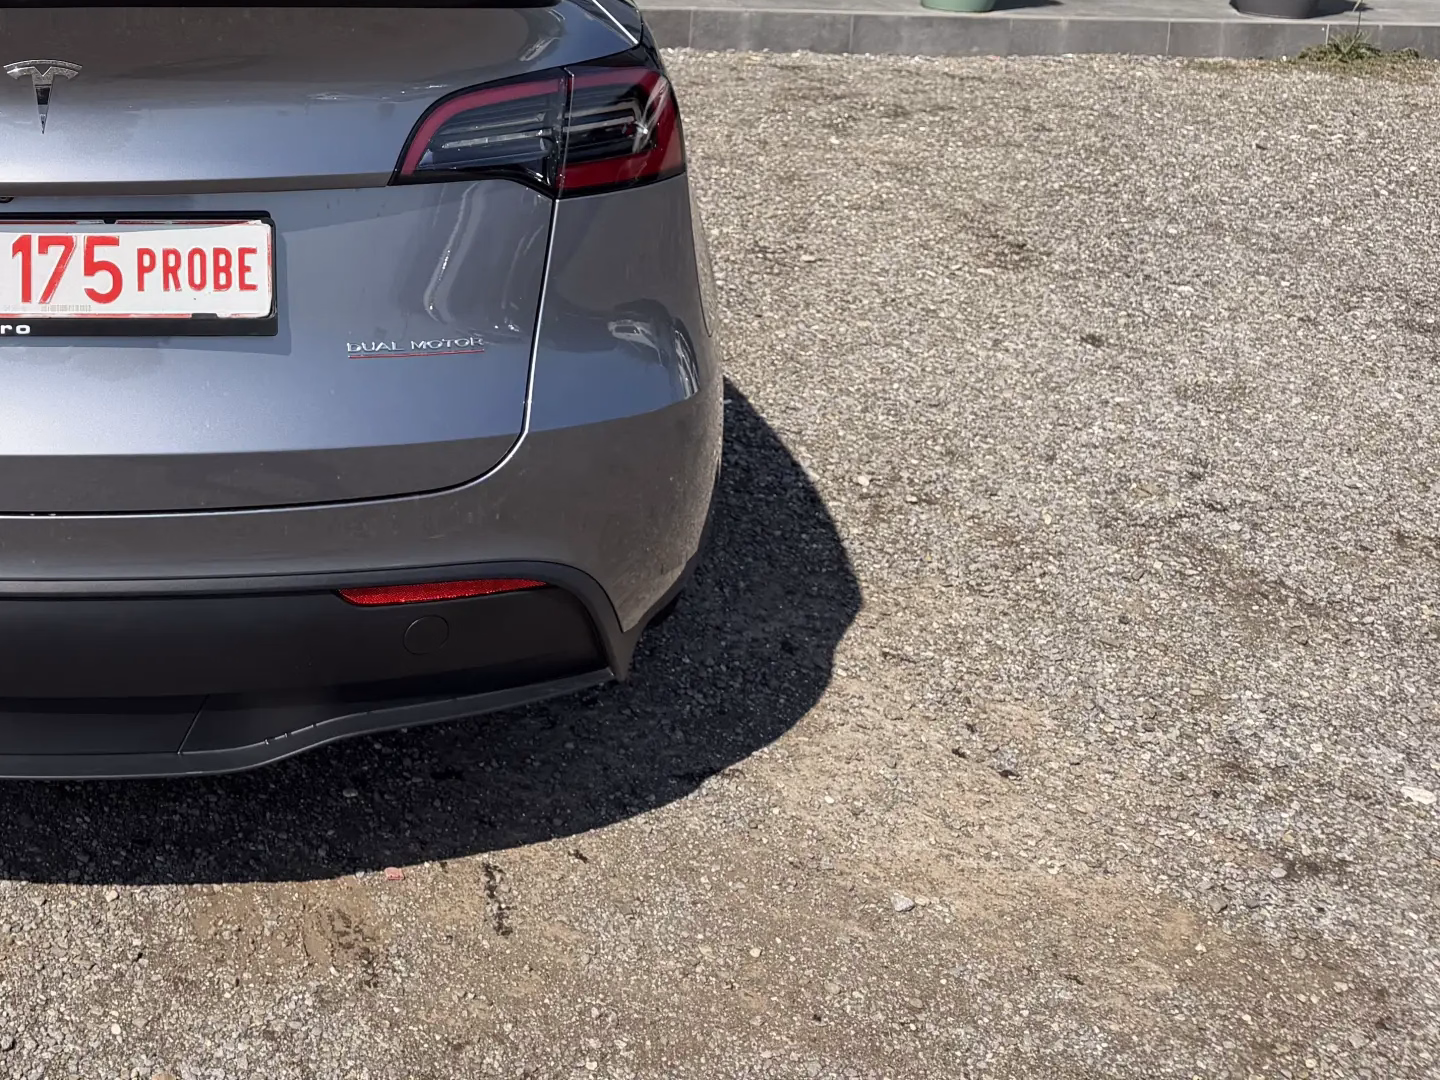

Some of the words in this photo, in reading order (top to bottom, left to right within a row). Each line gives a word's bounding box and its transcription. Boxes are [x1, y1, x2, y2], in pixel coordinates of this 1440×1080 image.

[12, 234, 123, 305] 175
[137, 247, 258, 292] PROBE
[347, 341, 404, 352] DUAL
[411, 336, 484, 350] MOTOR
